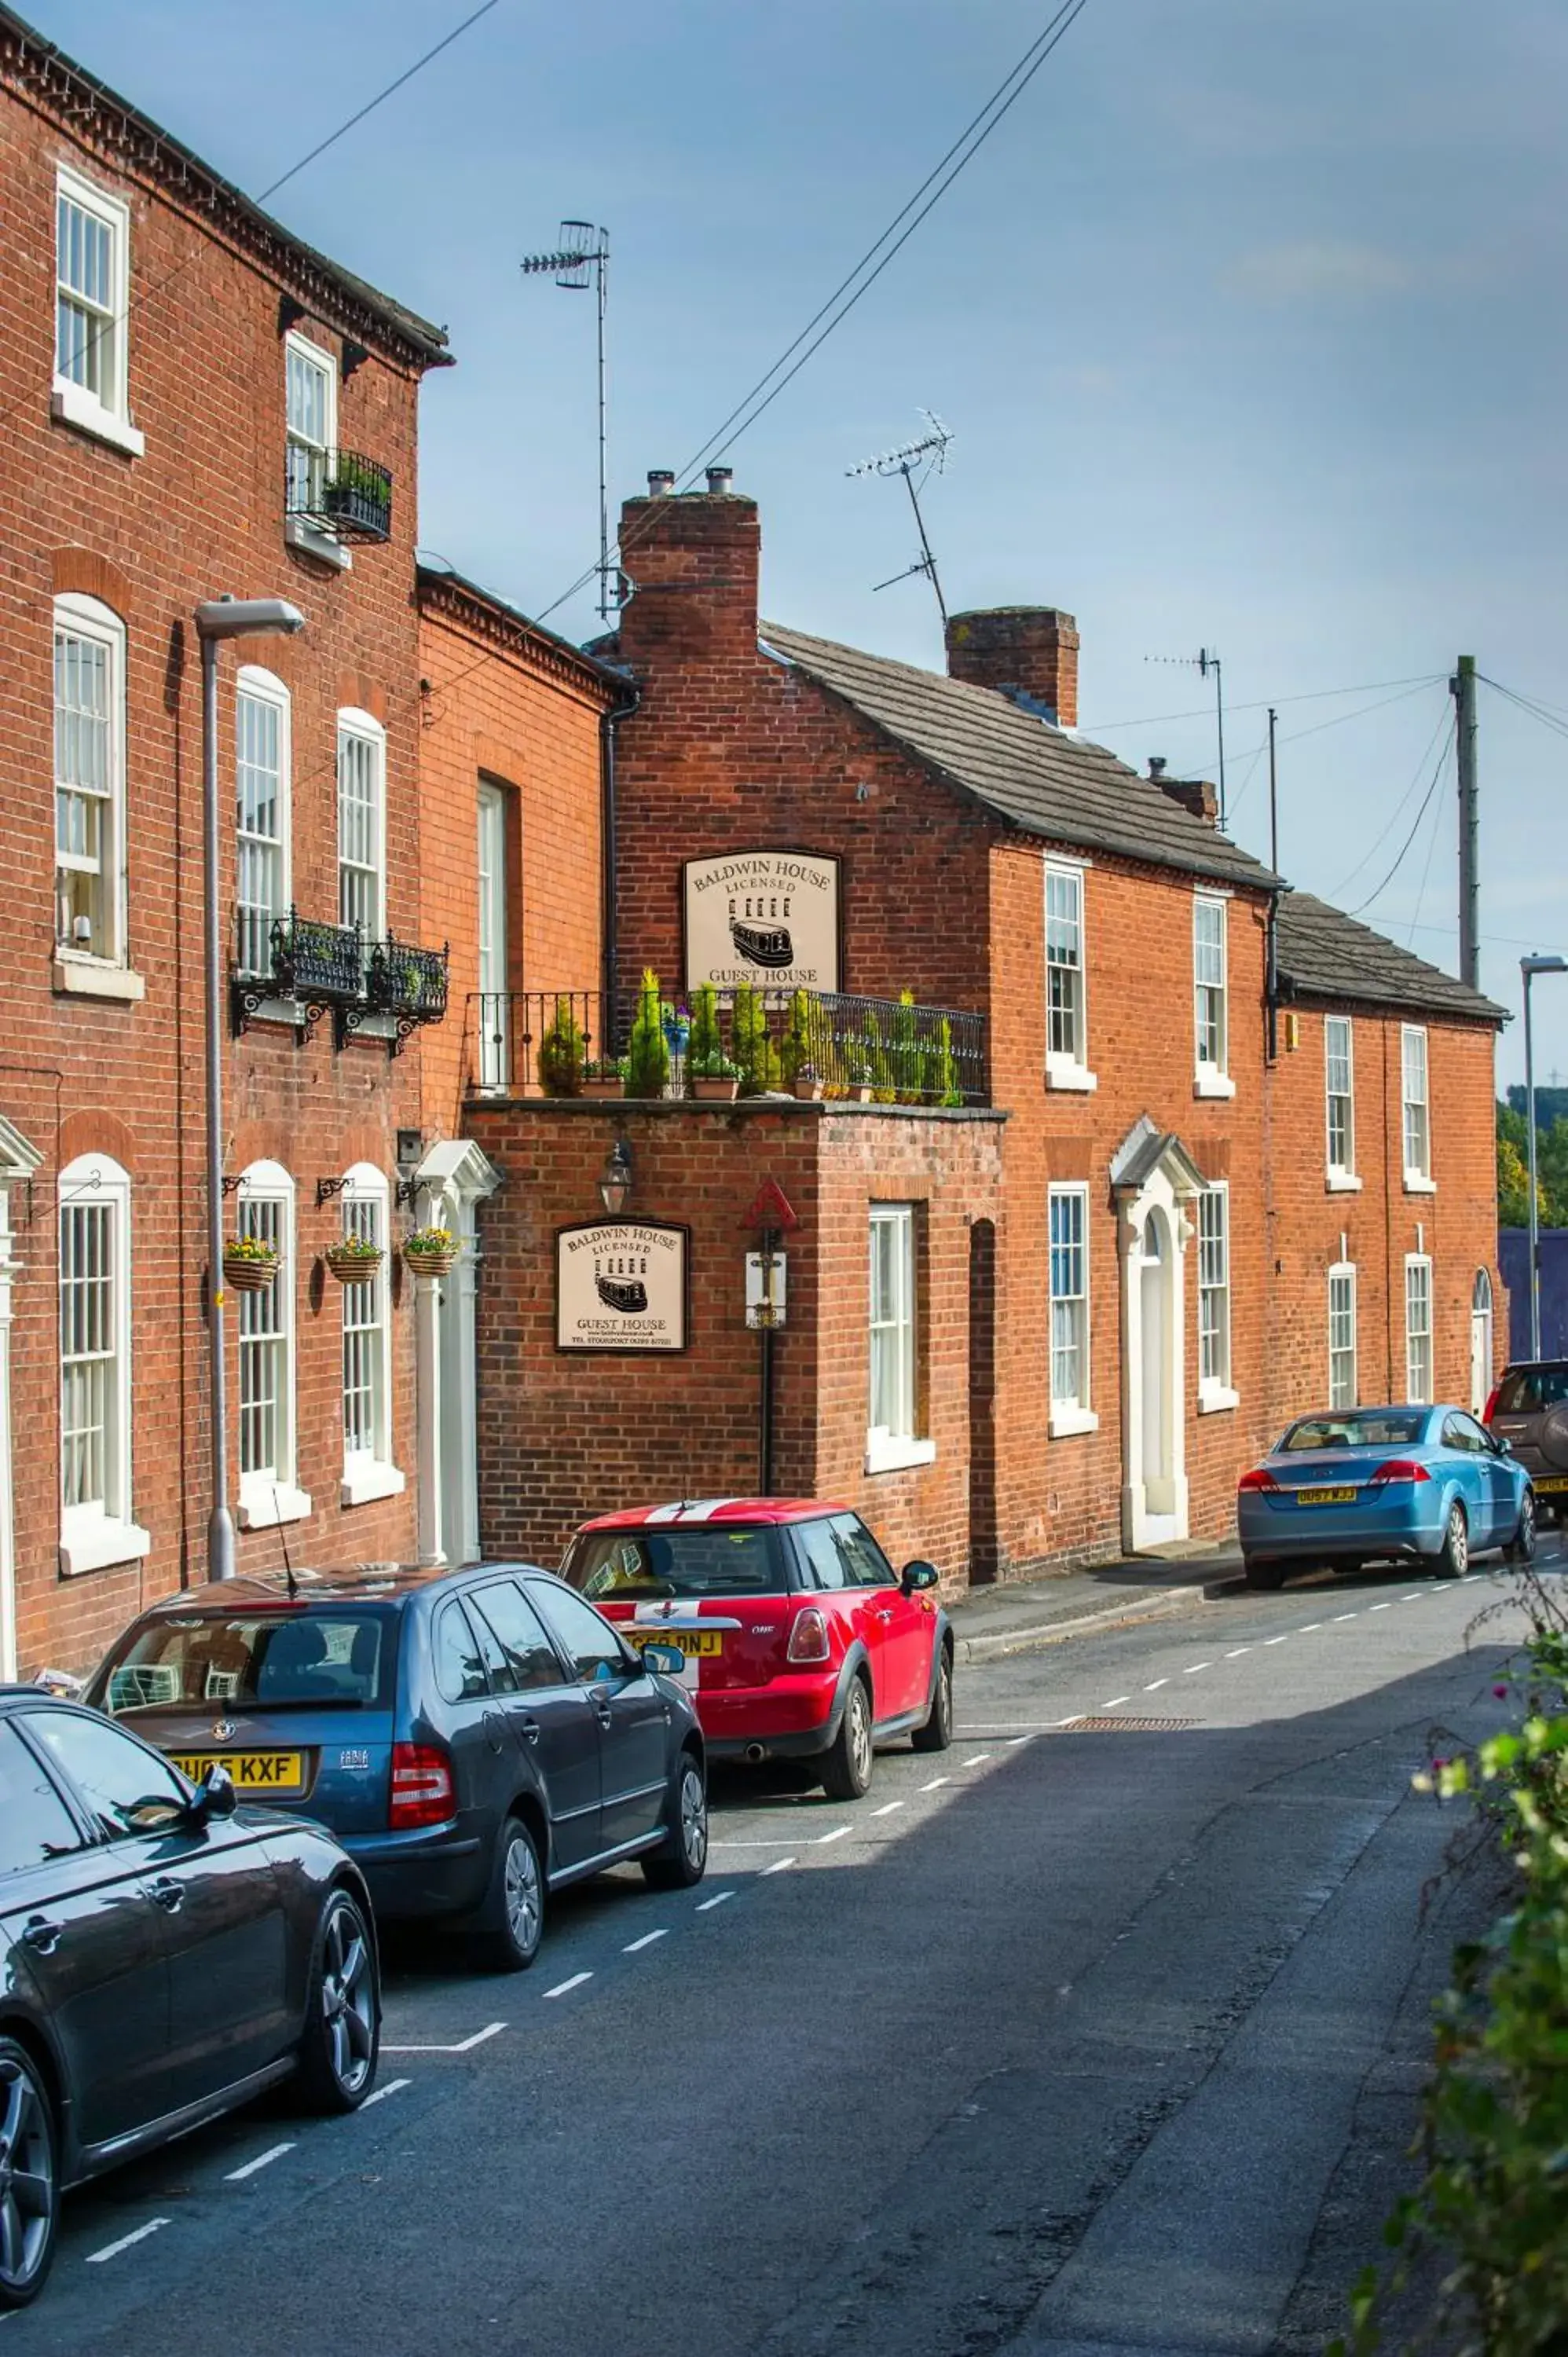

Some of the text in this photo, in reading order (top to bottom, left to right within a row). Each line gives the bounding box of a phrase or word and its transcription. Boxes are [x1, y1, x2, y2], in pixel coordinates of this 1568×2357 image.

[693, 860, 830, 893] BALDWIN HOUSE
[725, 878, 796, 893] LICENSED
[709, 969, 817, 982] GUEST HOUSE
[567, 1227, 677, 1252] BALDWIN HOUSE
[592, 1242, 651, 1255] LICENSED
[577, 1319, 667, 1330] GUEST HOUSE
[752, 1625, 775, 1635] ONE
[240, 1757, 291, 1782] KXF
